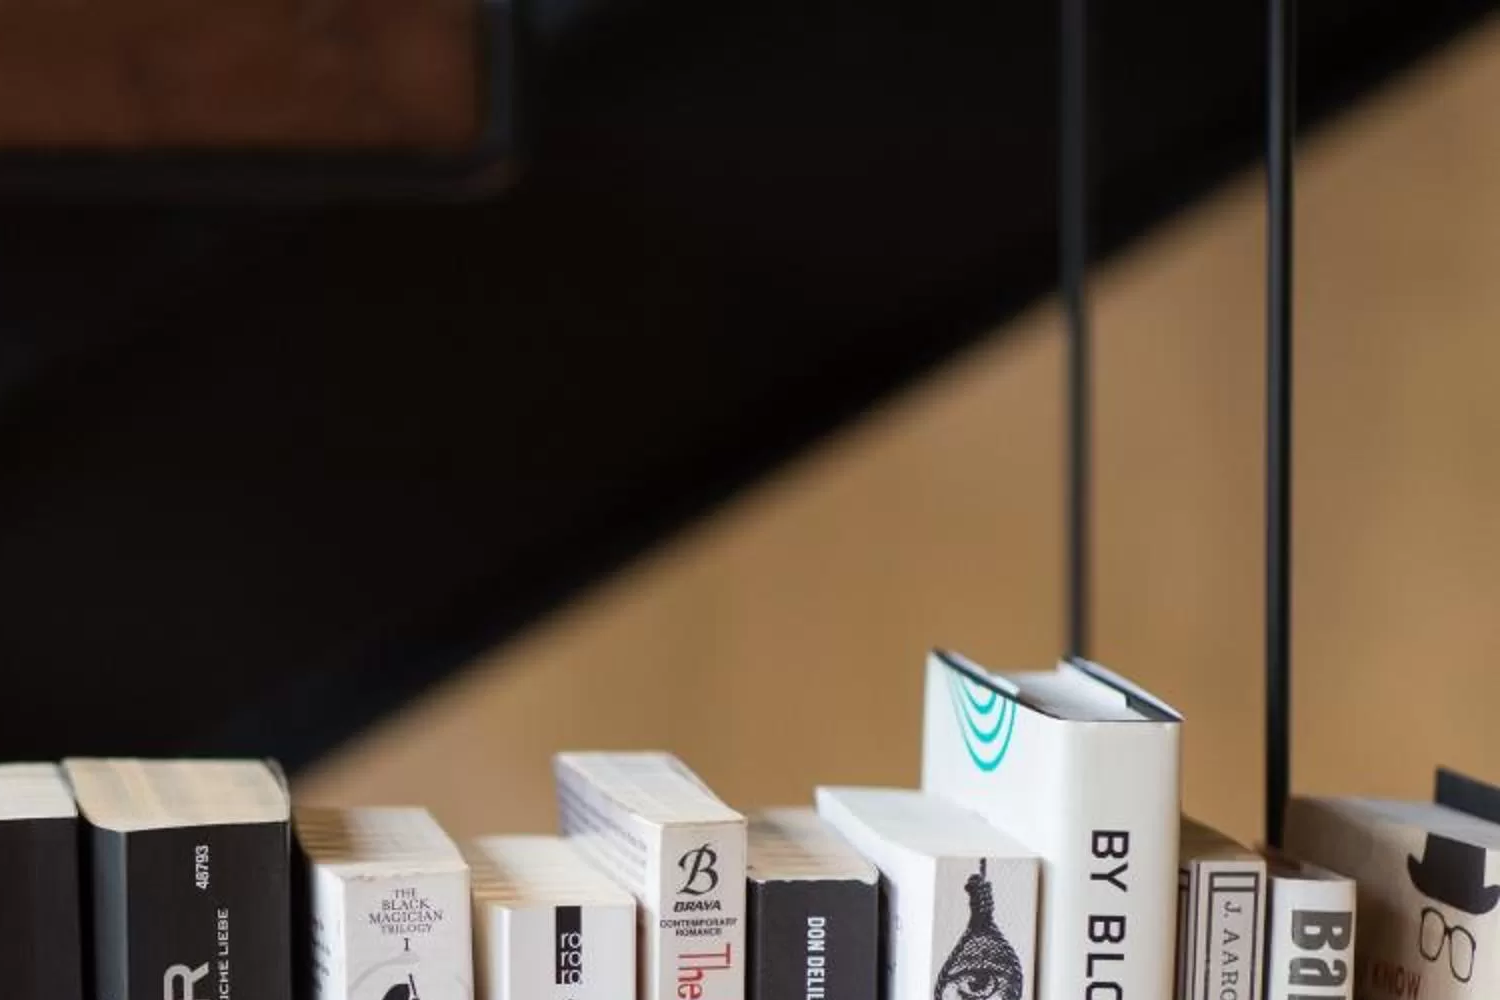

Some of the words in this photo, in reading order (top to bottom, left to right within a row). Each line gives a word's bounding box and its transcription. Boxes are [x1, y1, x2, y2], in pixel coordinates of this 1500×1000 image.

[1090, 829, 1130, 893] BY
[215, 907, 230, 956] LIEBE
[806, 915, 826, 951] DON
[675, 942, 732, 1000] The
